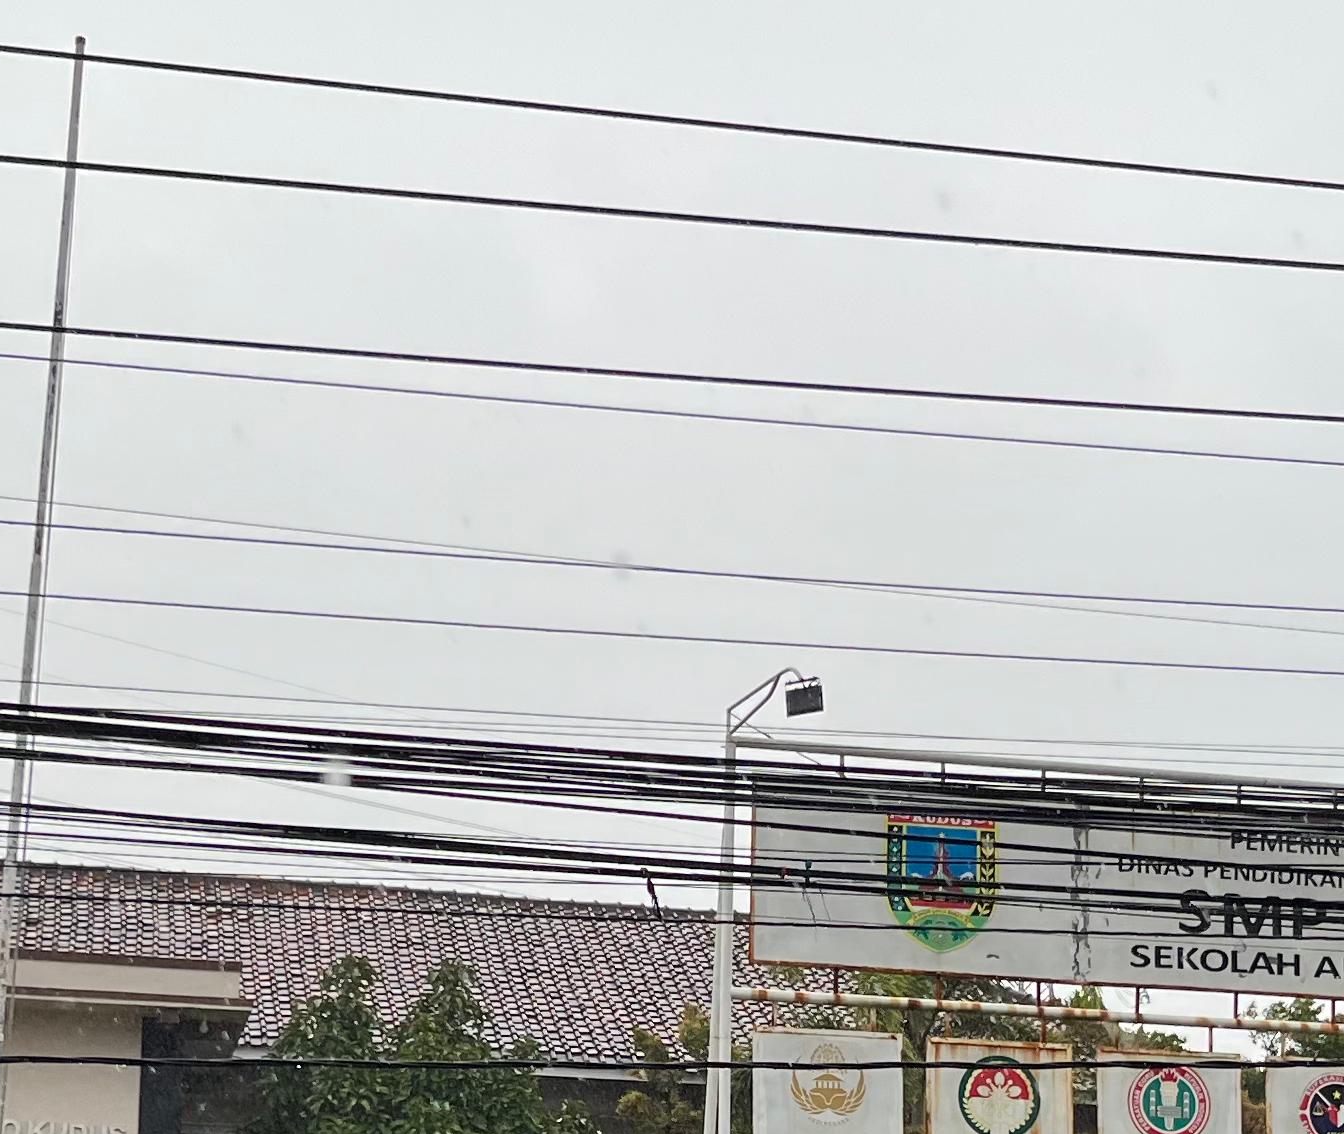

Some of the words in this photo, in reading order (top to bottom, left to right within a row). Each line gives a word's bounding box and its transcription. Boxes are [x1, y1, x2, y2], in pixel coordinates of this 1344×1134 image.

[1117, 857, 1194, 877] DINAS
[1179, 889, 1329, 939] SMP
[1130, 944, 1302, 977] SEKOLAH
